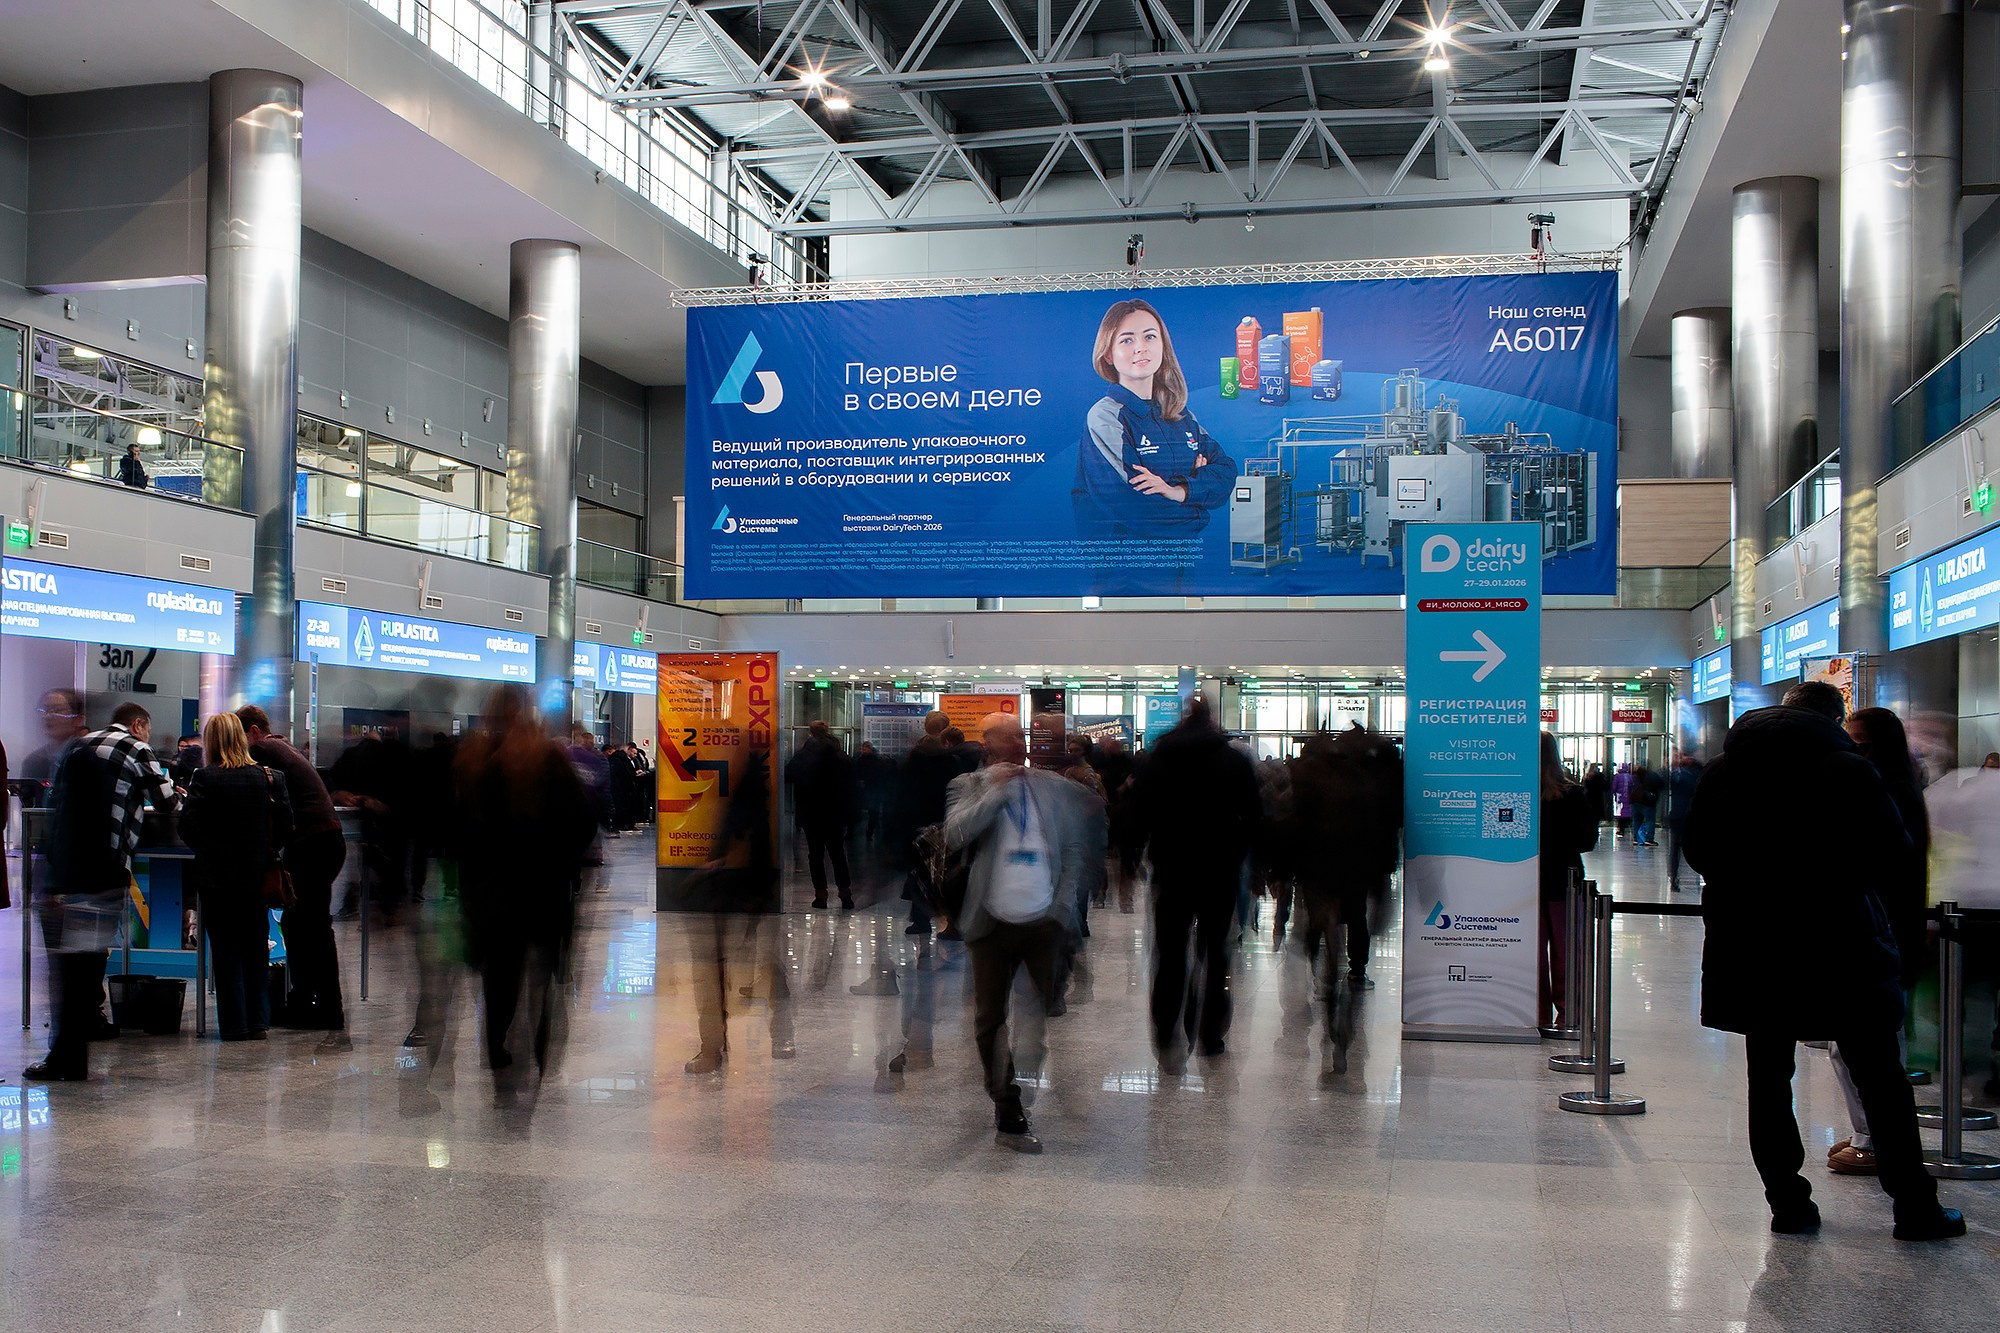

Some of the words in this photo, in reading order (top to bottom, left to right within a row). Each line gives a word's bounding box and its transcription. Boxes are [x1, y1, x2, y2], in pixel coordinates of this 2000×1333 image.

[1488, 305, 1528, 319] Наш
[1533, 305, 1586, 319] стенд
[1488, 325, 1585, 352] А6017
[845, 362, 957, 390] Первые
[844, 395, 858, 411] в
[868, 391, 960, 410] своем
[968, 388, 1042, 411] деле
[712, 438, 782, 454] Ведущий
[786, 437, 907, 453] производитель
[911, 435, 1026, 451] упаковочного
[712, 456, 802, 470] материала,
[807, 454, 894, 468] поставщик
[899, 451, 1045, 467] интегрированных
[711, 474, 780, 489] решений
[785, 477, 794, 486] в
[798, 472, 914, 488] оборудовании
[918, 473, 928, 483] и
[932, 470, 1011, 486] сервисах
[739, 517, 799, 526] Упаковочные
[843, 513, 897, 522] Генеральный
[898, 513, 933, 522] партнер
[738, 525, 779, 533] Системы
[843, 524, 881, 532] выставки
[883, 523, 922, 533] DairyTech
[923, 522, 943, 531] 2026
[1466, 537, 1527, 564] dairy
[1466, 557, 1512, 572] tech
[1937, 546, 1986, 587] RUPLASTICA
[1464, 579, 1527, 587] 27-29.01.2026
[147, 590, 223, 615] ruplastica.ru
[1426, 601, 1521, 610] #И_МОЛОКО_И_МЯСО
[380, 620, 439, 643] RUPLASTICA
[99, 644, 134, 670] Зал
[1161, 700, 1178, 709] dairy
[1419, 699, 1527, 711] РЕГИСТРАЦИЯ
[1419, 712, 1527, 724] ПОСЕТИТЕЛЕЙ
[1618, 710, 1646, 719] ВЫХОД
[1077, 718, 1121, 732] Полимерный
[683, 728, 697, 747] 2
[703, 735, 740, 746] 2026
[1449, 739, 1497, 749] VISITOR
[1429, 751, 1516, 761] REGISTRATION
[1423, 789, 1476, 800] DairyTech
[1454, 915, 1520, 924] Упаковочные
[1454, 923, 1497, 931] Системы
